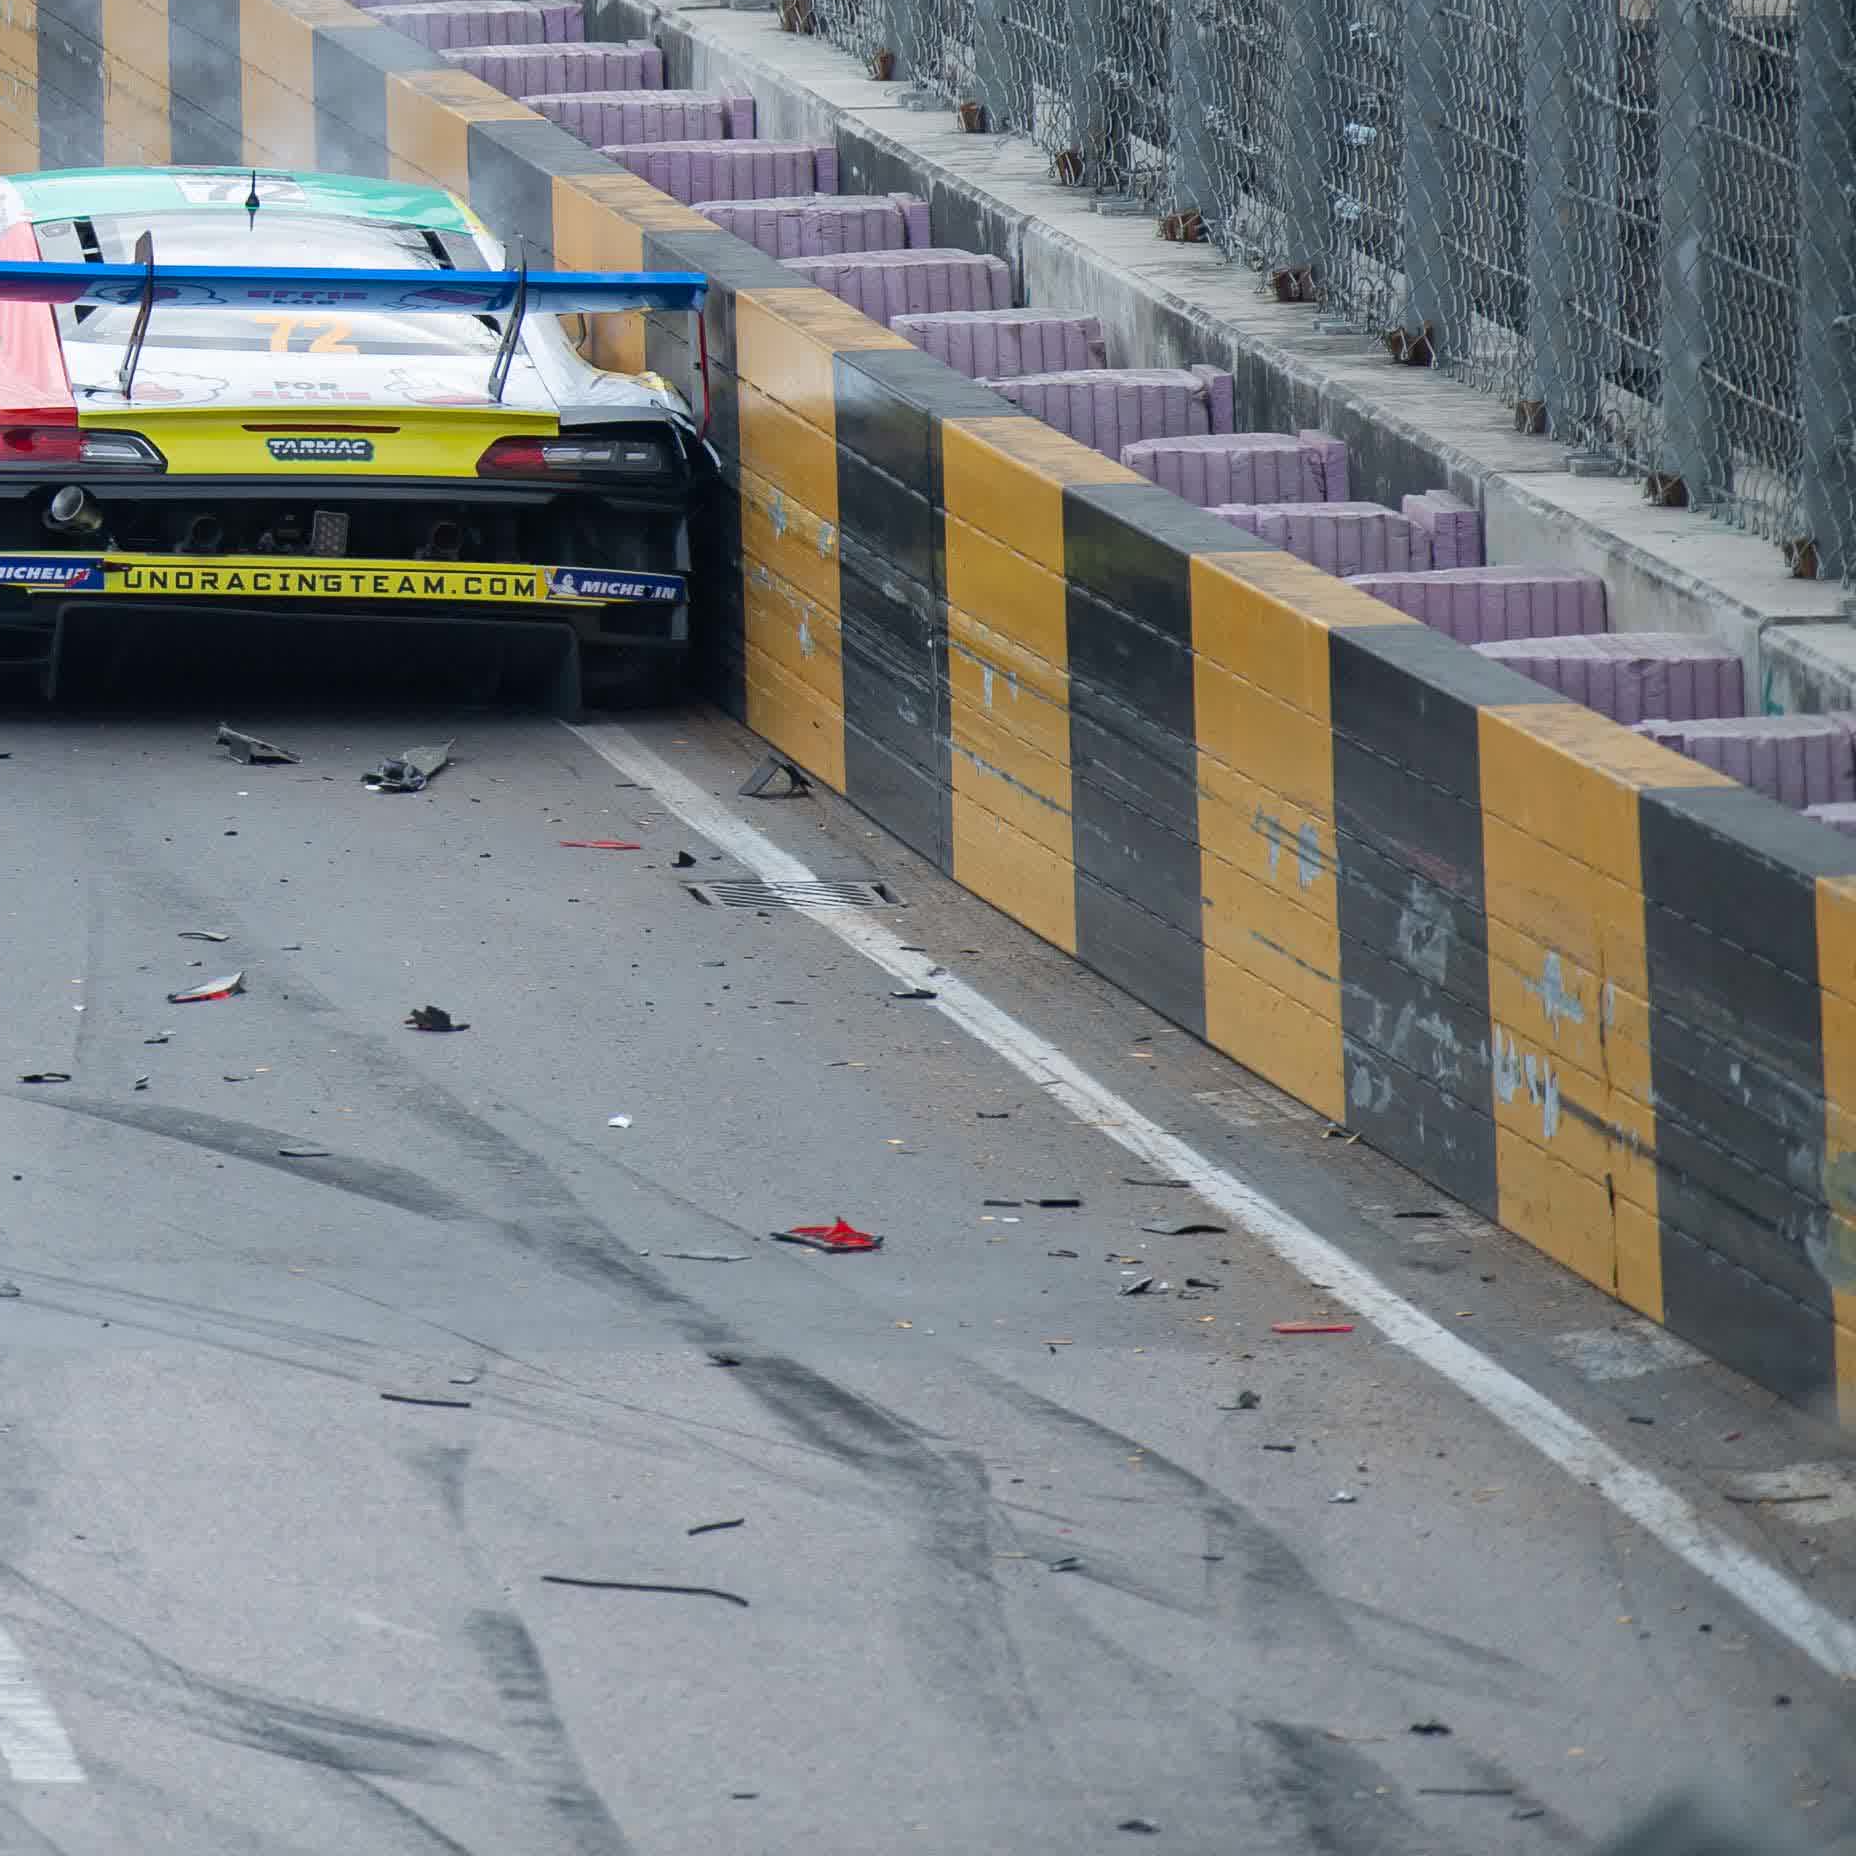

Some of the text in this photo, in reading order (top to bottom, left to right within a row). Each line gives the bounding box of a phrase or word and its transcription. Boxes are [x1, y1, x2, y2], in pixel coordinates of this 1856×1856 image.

[255, 314, 361, 353] 72
[273, 380, 340, 391] FOR
[269, 440, 366, 455] TARMAC
[124, 568, 535, 597] UNORACINGTEAM.COM
[580, 580, 677, 600] MICHEIN
